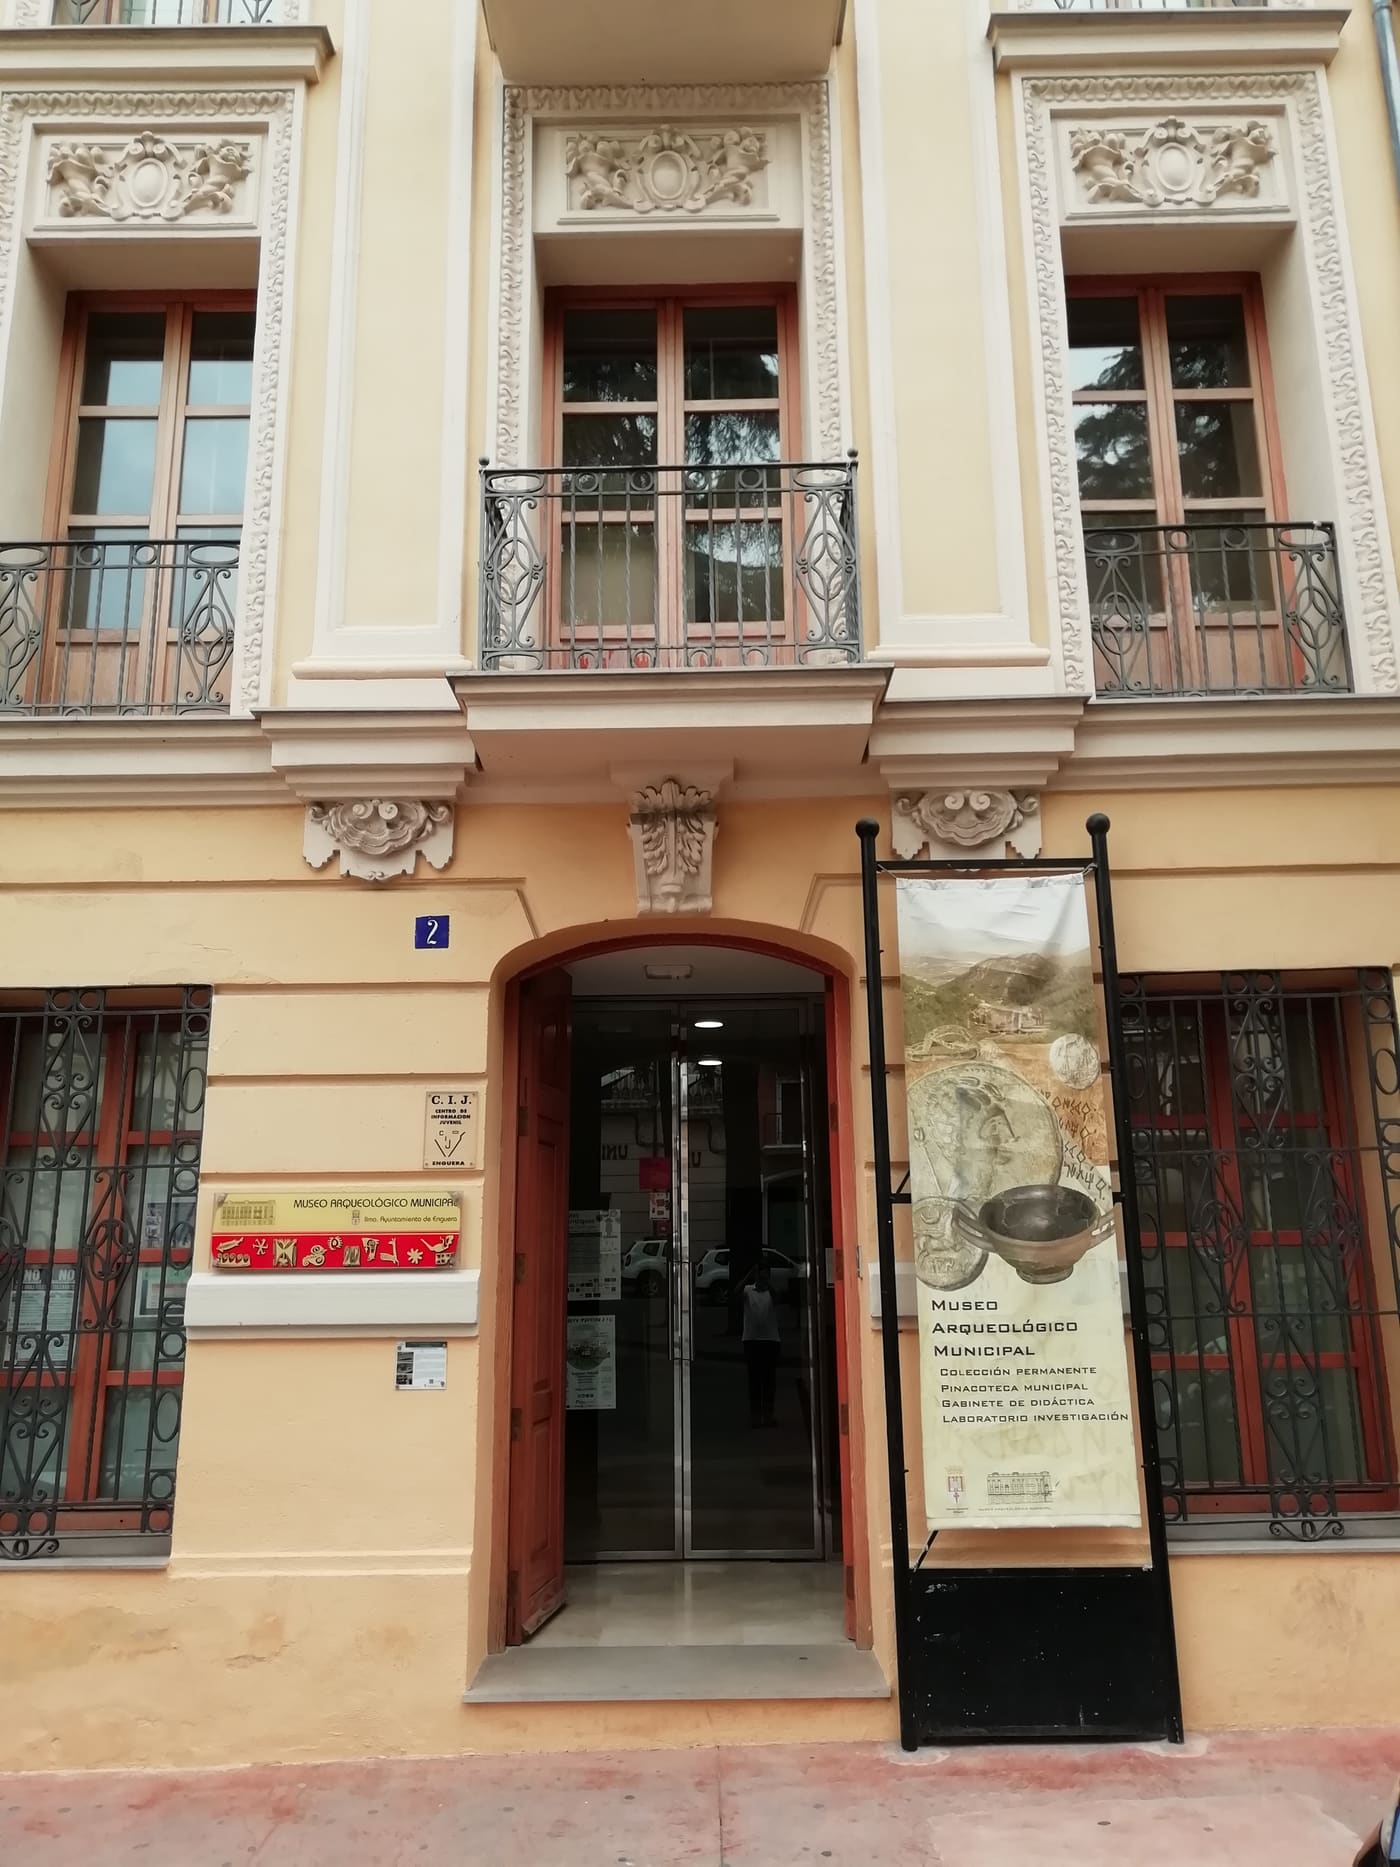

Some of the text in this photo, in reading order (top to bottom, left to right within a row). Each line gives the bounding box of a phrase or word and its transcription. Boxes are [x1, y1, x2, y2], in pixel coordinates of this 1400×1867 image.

[427, 919, 438, 944] 2
[431, 1095, 472, 1105] C. I. J.
[293, 1199, 328, 1208] MUSEO
[330, 1197, 408, 1209] ARQUEOLÓGICO
[380, 1215, 422, 1224] Ayuntamiento
[432, 1215, 458, 1224] Enguera
[24, 1269, 76, 1281] NO NO
[931, 1300, 998, 1311] MUSEO
[932, 1319, 1078, 1335] ARQUEOLÓGICO
[934, 1345, 1035, 1357] MUNICIPAL
[940, 1366, 1097, 1376] COLECCIÓN PERMANENTE
[941, 1383, 1088, 1393] PINACOTECA MUNICIPAL
[942, 1396, 1095, 1408] GABINETE DE DIDÁCTICA
[943, 1411, 1129, 1423] LABORATORIO INVESTIGACIÓN
